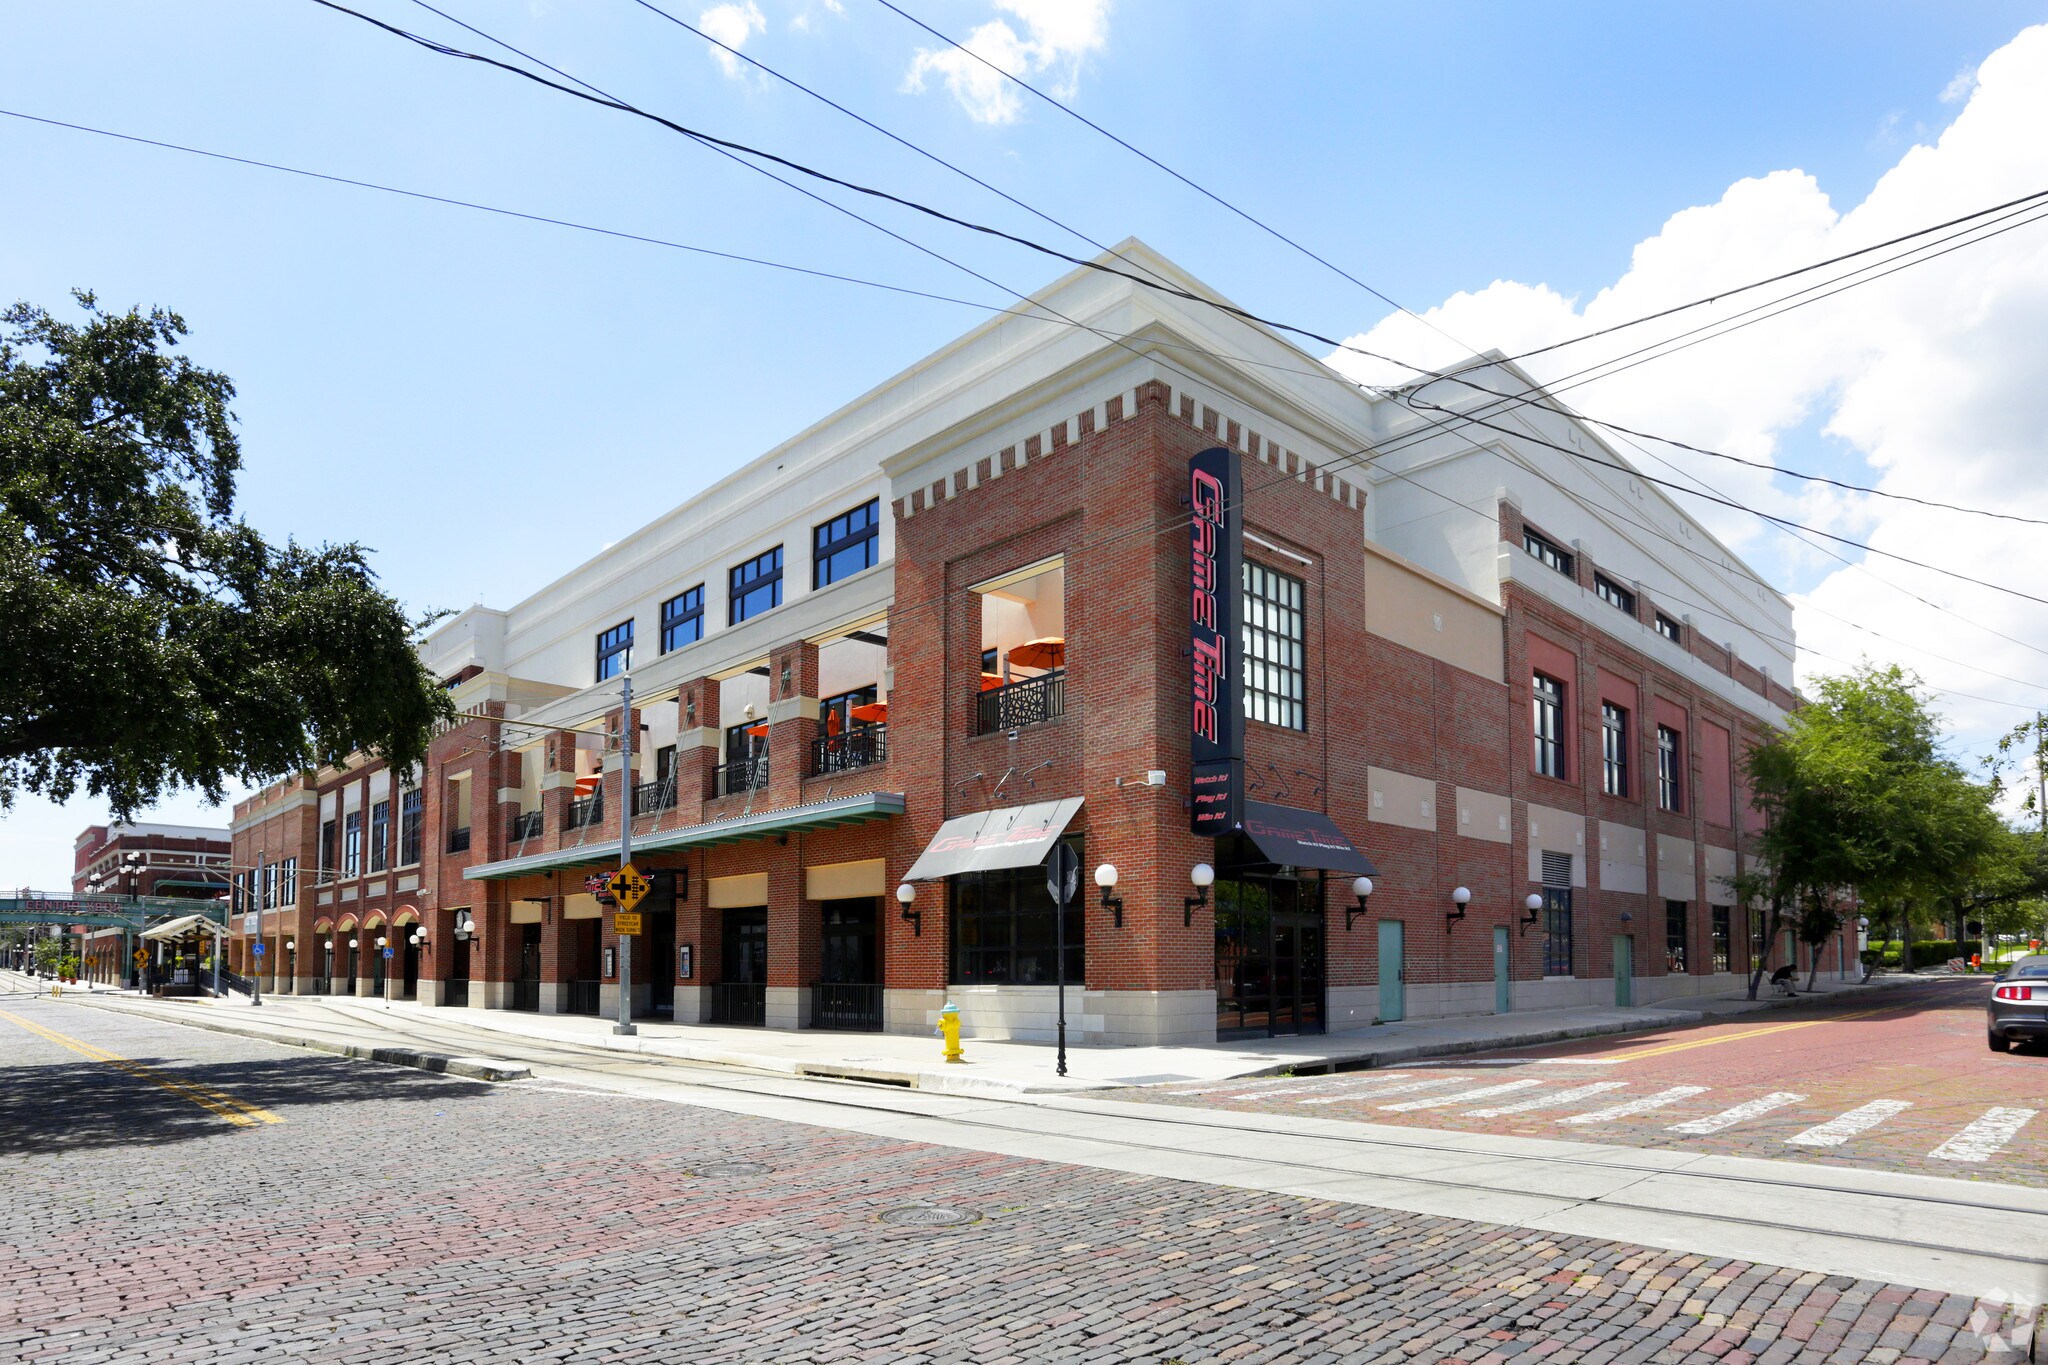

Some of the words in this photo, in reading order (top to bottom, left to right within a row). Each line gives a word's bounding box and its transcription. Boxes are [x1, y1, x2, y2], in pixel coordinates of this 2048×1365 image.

[1194, 775, 1217, 784] Watch
[1217, 774, 1229, 782] it!
[1195, 794, 1216, 803] Play
[1215, 792, 1228, 801] it!
[1196, 813, 1214, 821] Win
[1213, 811, 1226, 820] it!
[26, 900, 81, 911] CENTRO
[86, 901, 121, 913] YBOR
